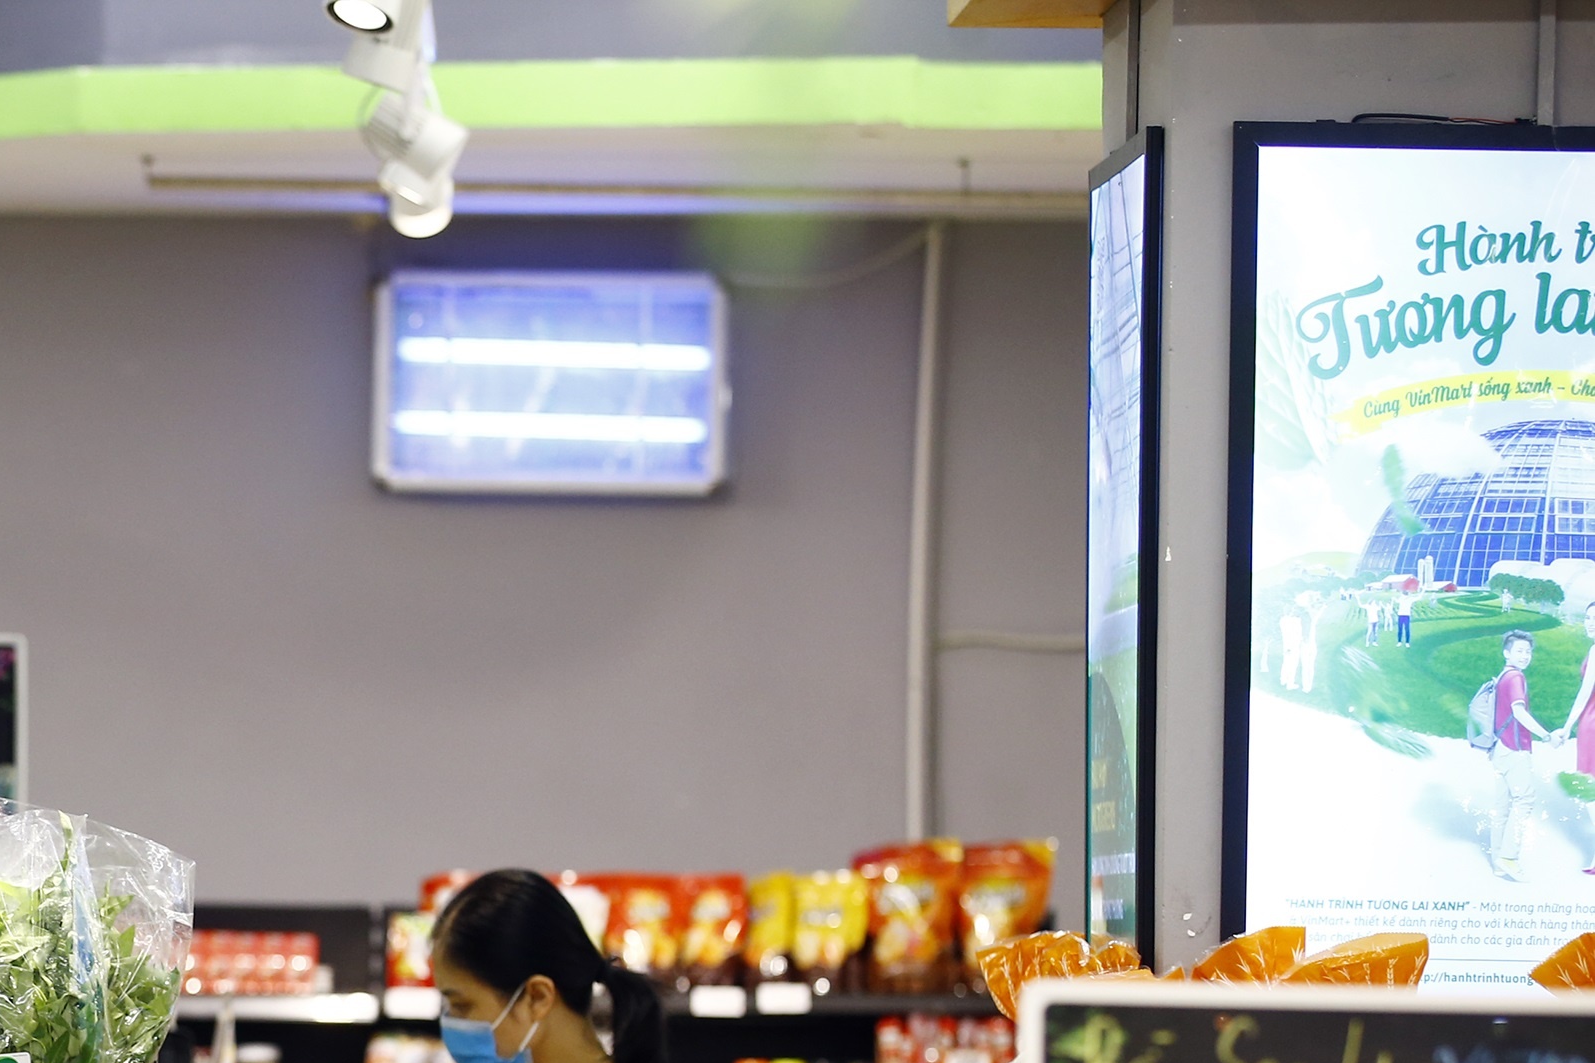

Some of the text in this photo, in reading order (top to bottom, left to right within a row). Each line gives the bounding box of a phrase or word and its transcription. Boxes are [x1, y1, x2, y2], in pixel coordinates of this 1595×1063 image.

[1416, 220, 1562, 276] Hành
[1296, 271, 1595, 379] Tương la
[1363, 398, 1401, 419] Cùng
[1406, 380, 1473, 408] VinMart
[1477, 376, 1511, 402] sống
[1515, 376, 1552, 395] xanh
[1412, 900, 1429, 911] LAI
[1504, 902, 1534, 915] trong
[1430, 918, 1457, 930] riêng
[1461, 918, 1481, 929] cho
[1504, 918, 1537, 930] khách
[1540, 919, 1567, 932] hàng
[1430, 933, 1457, 944] dành
[1460, 934, 1481, 945] cho
[1484, 934, 1502, 945] các
[1506, 936, 1522, 947] gia
[1525, 935, 1550, 946] đình
